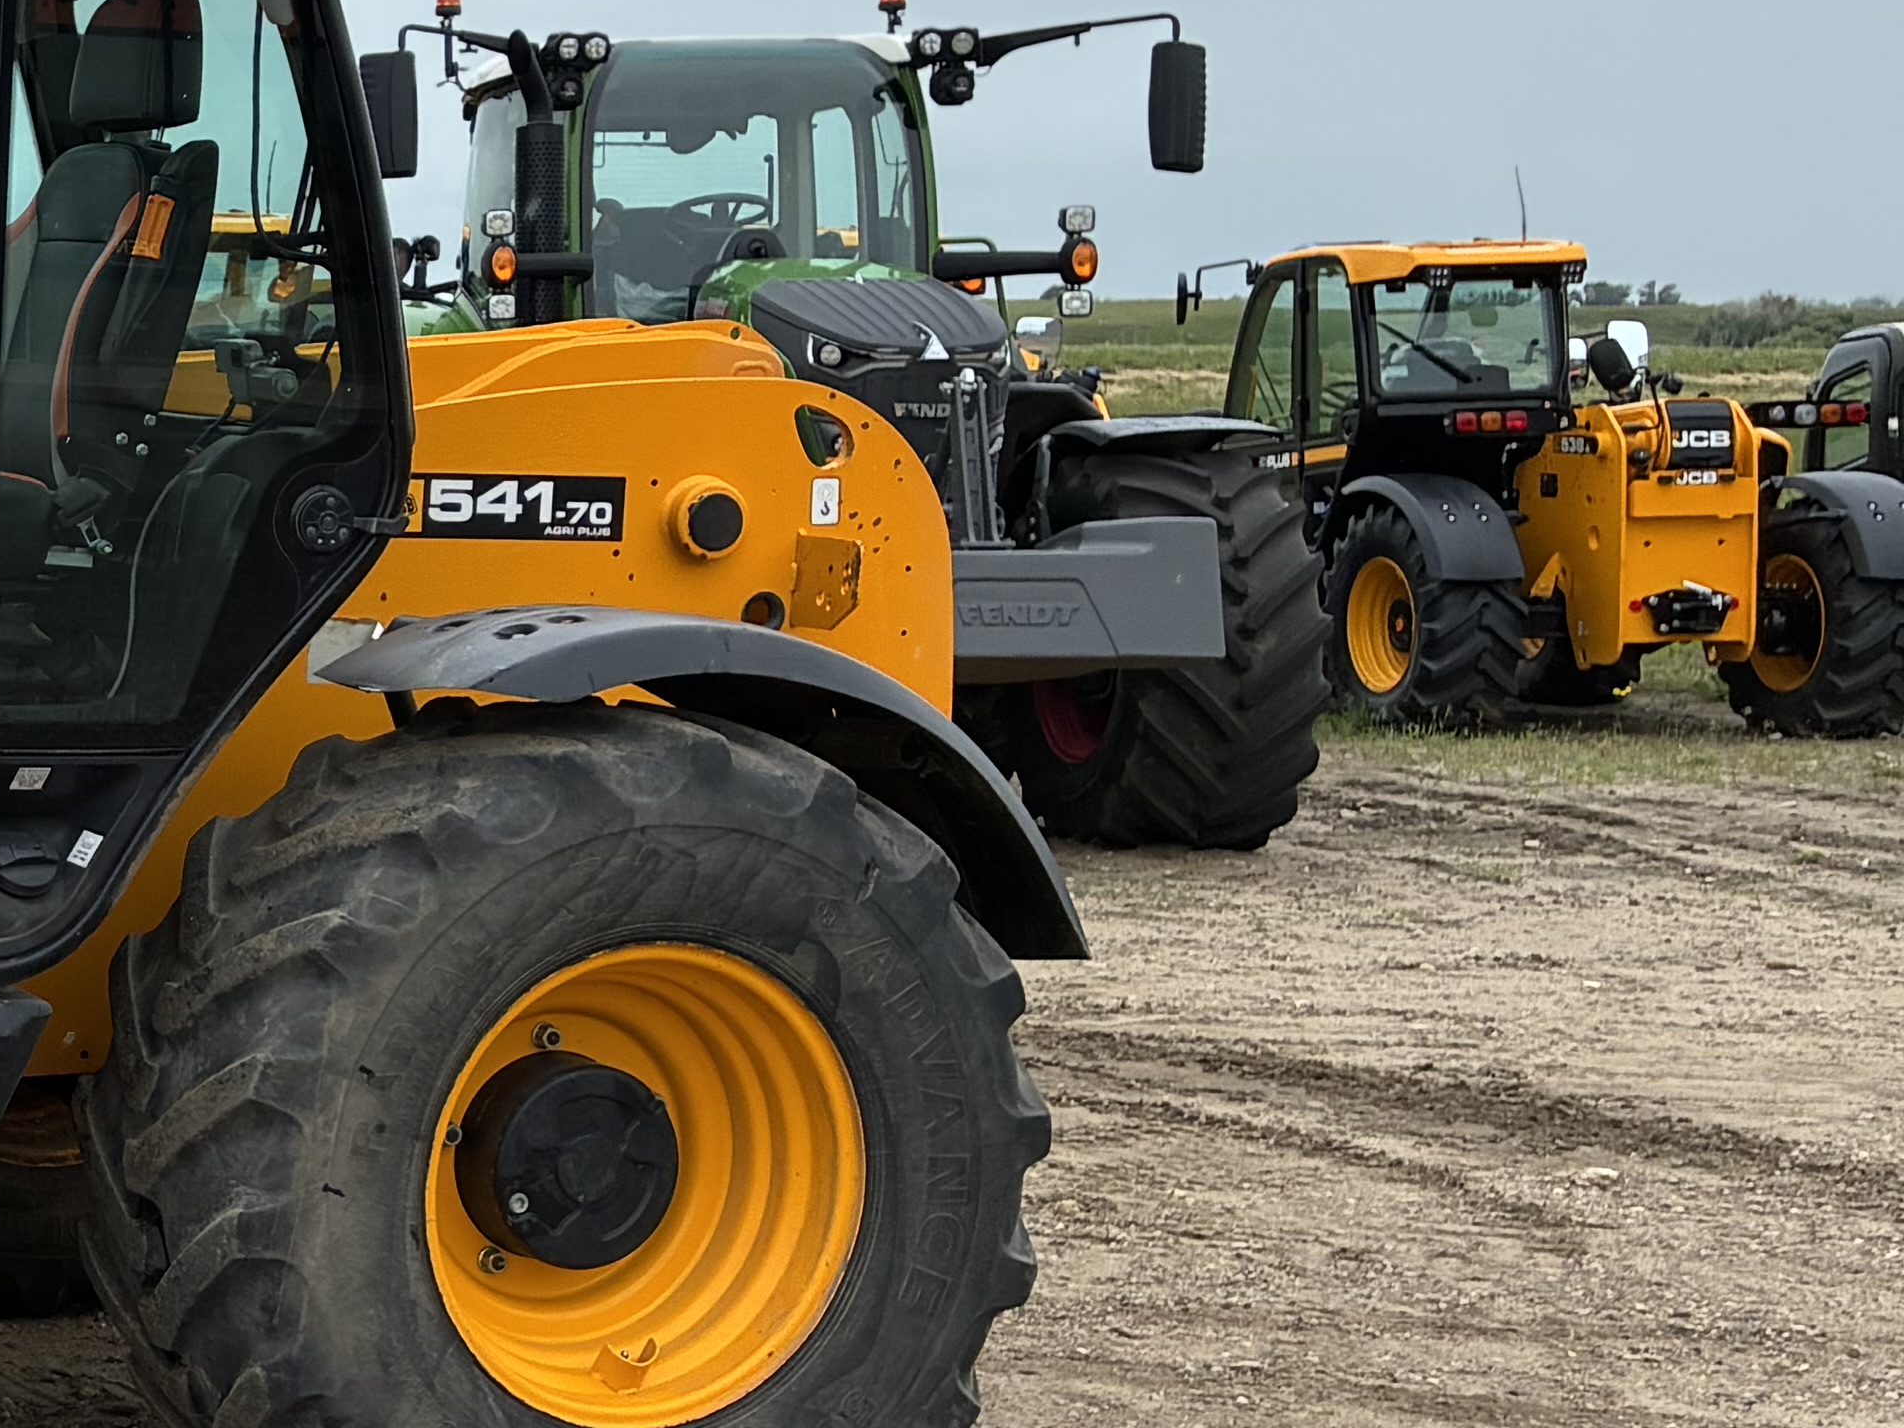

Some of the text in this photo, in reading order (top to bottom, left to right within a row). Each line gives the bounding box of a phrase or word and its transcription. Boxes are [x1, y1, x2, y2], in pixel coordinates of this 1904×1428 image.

[893, 402, 953, 418] FEND
[1671, 429, 1731, 449] JCB
[1675, 469, 1718, 486] JCB
[427, 478, 614, 525] 541-70
[956, 603, 1081, 627] FENDT
[841, 934, 974, 1320] ADVANCE
